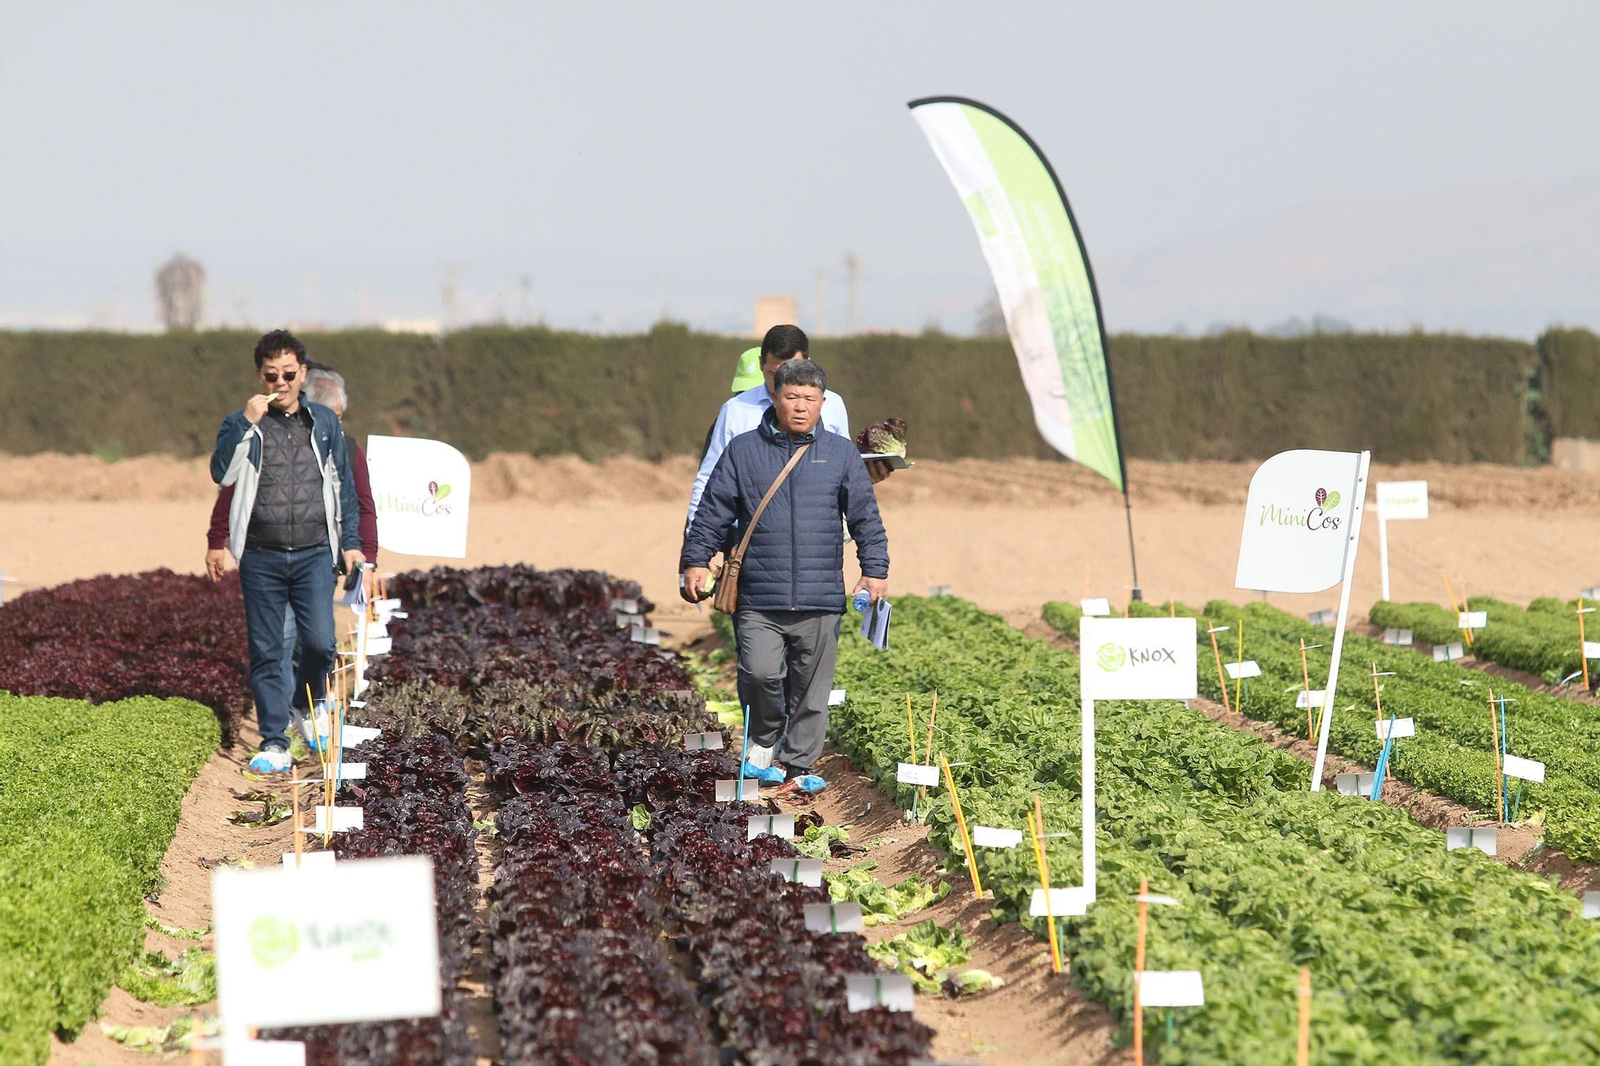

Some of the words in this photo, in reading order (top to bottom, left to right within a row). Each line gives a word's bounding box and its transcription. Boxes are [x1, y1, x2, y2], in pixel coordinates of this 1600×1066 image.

[378, 493, 452, 517] MiniCos
[1259, 504, 1342, 531] MiniCos
[1129, 647, 1176, 667] KNOX
